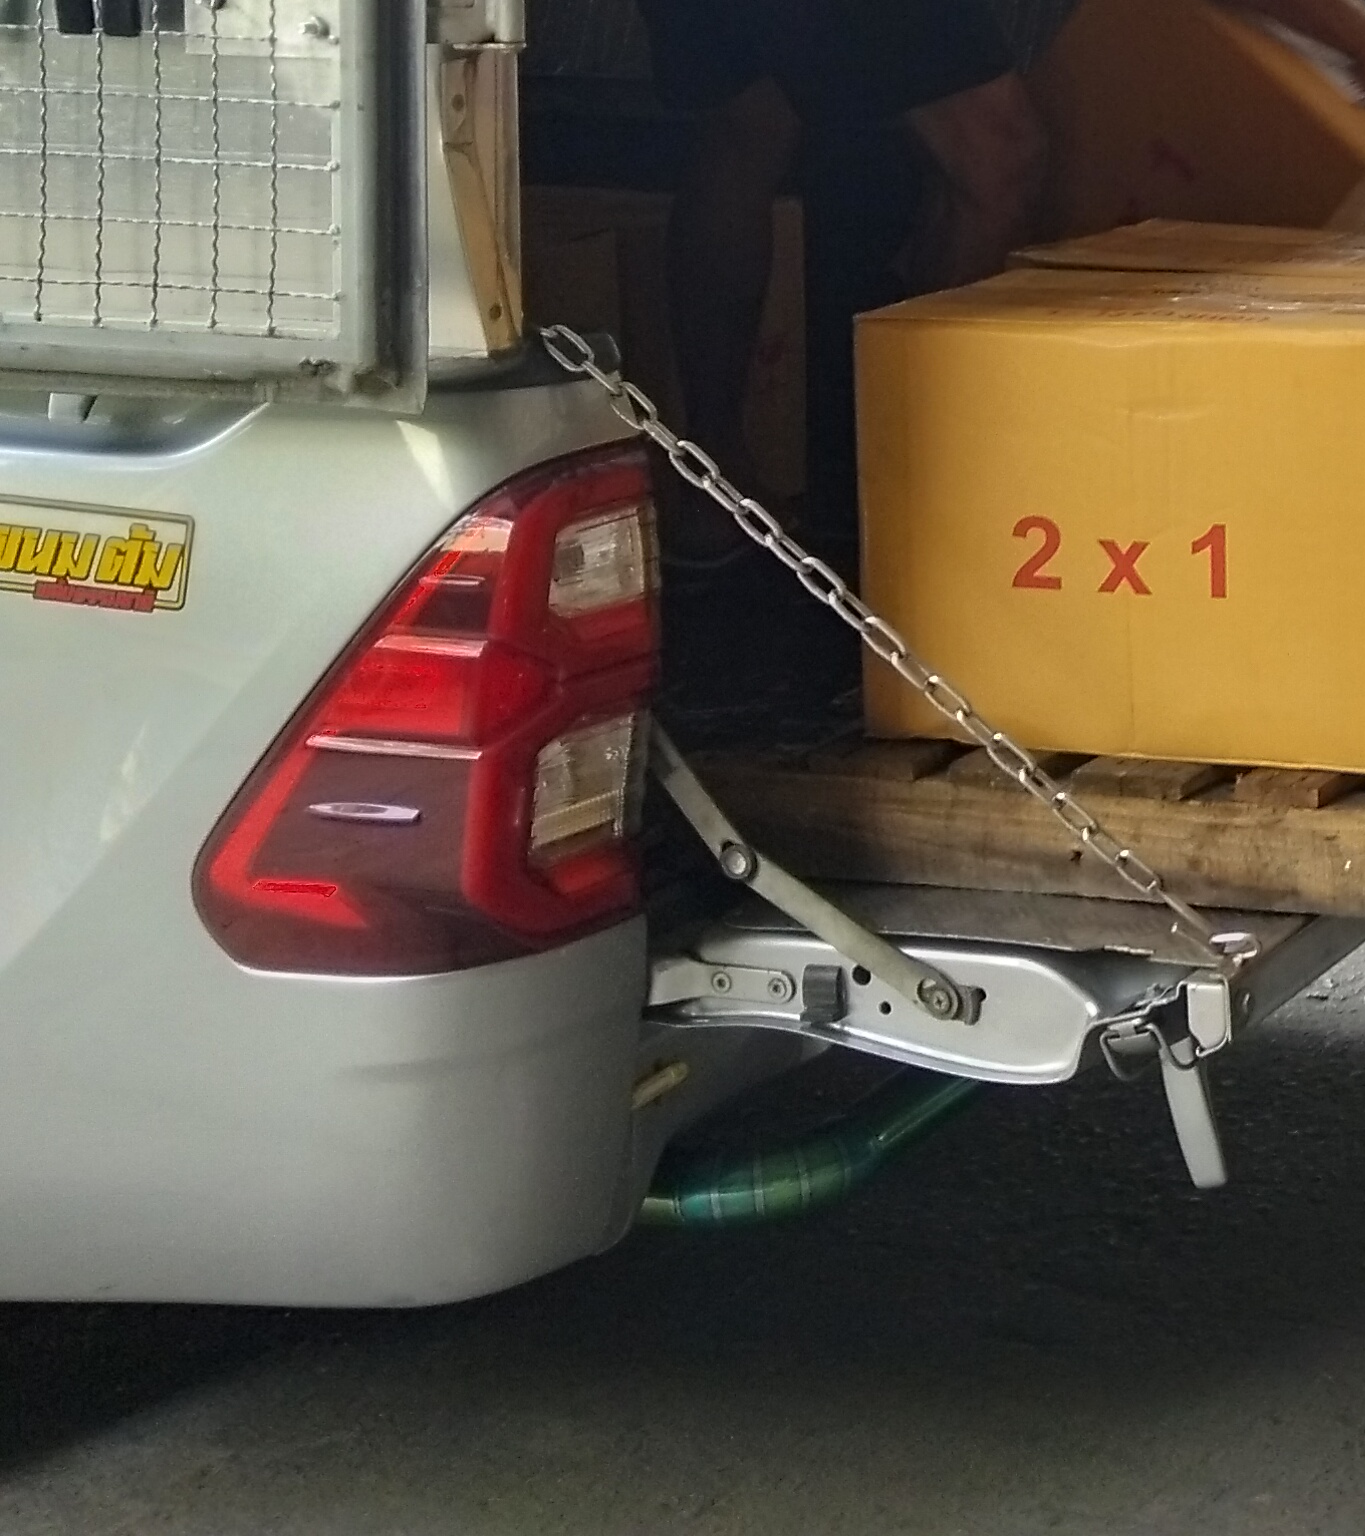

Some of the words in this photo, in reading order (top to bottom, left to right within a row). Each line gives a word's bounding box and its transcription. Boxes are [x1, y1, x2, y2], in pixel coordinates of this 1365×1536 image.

[1011, 514, 1063, 591] 2
[1096, 538, 1154, 596] x
[1191, 522, 1228, 600] 1
